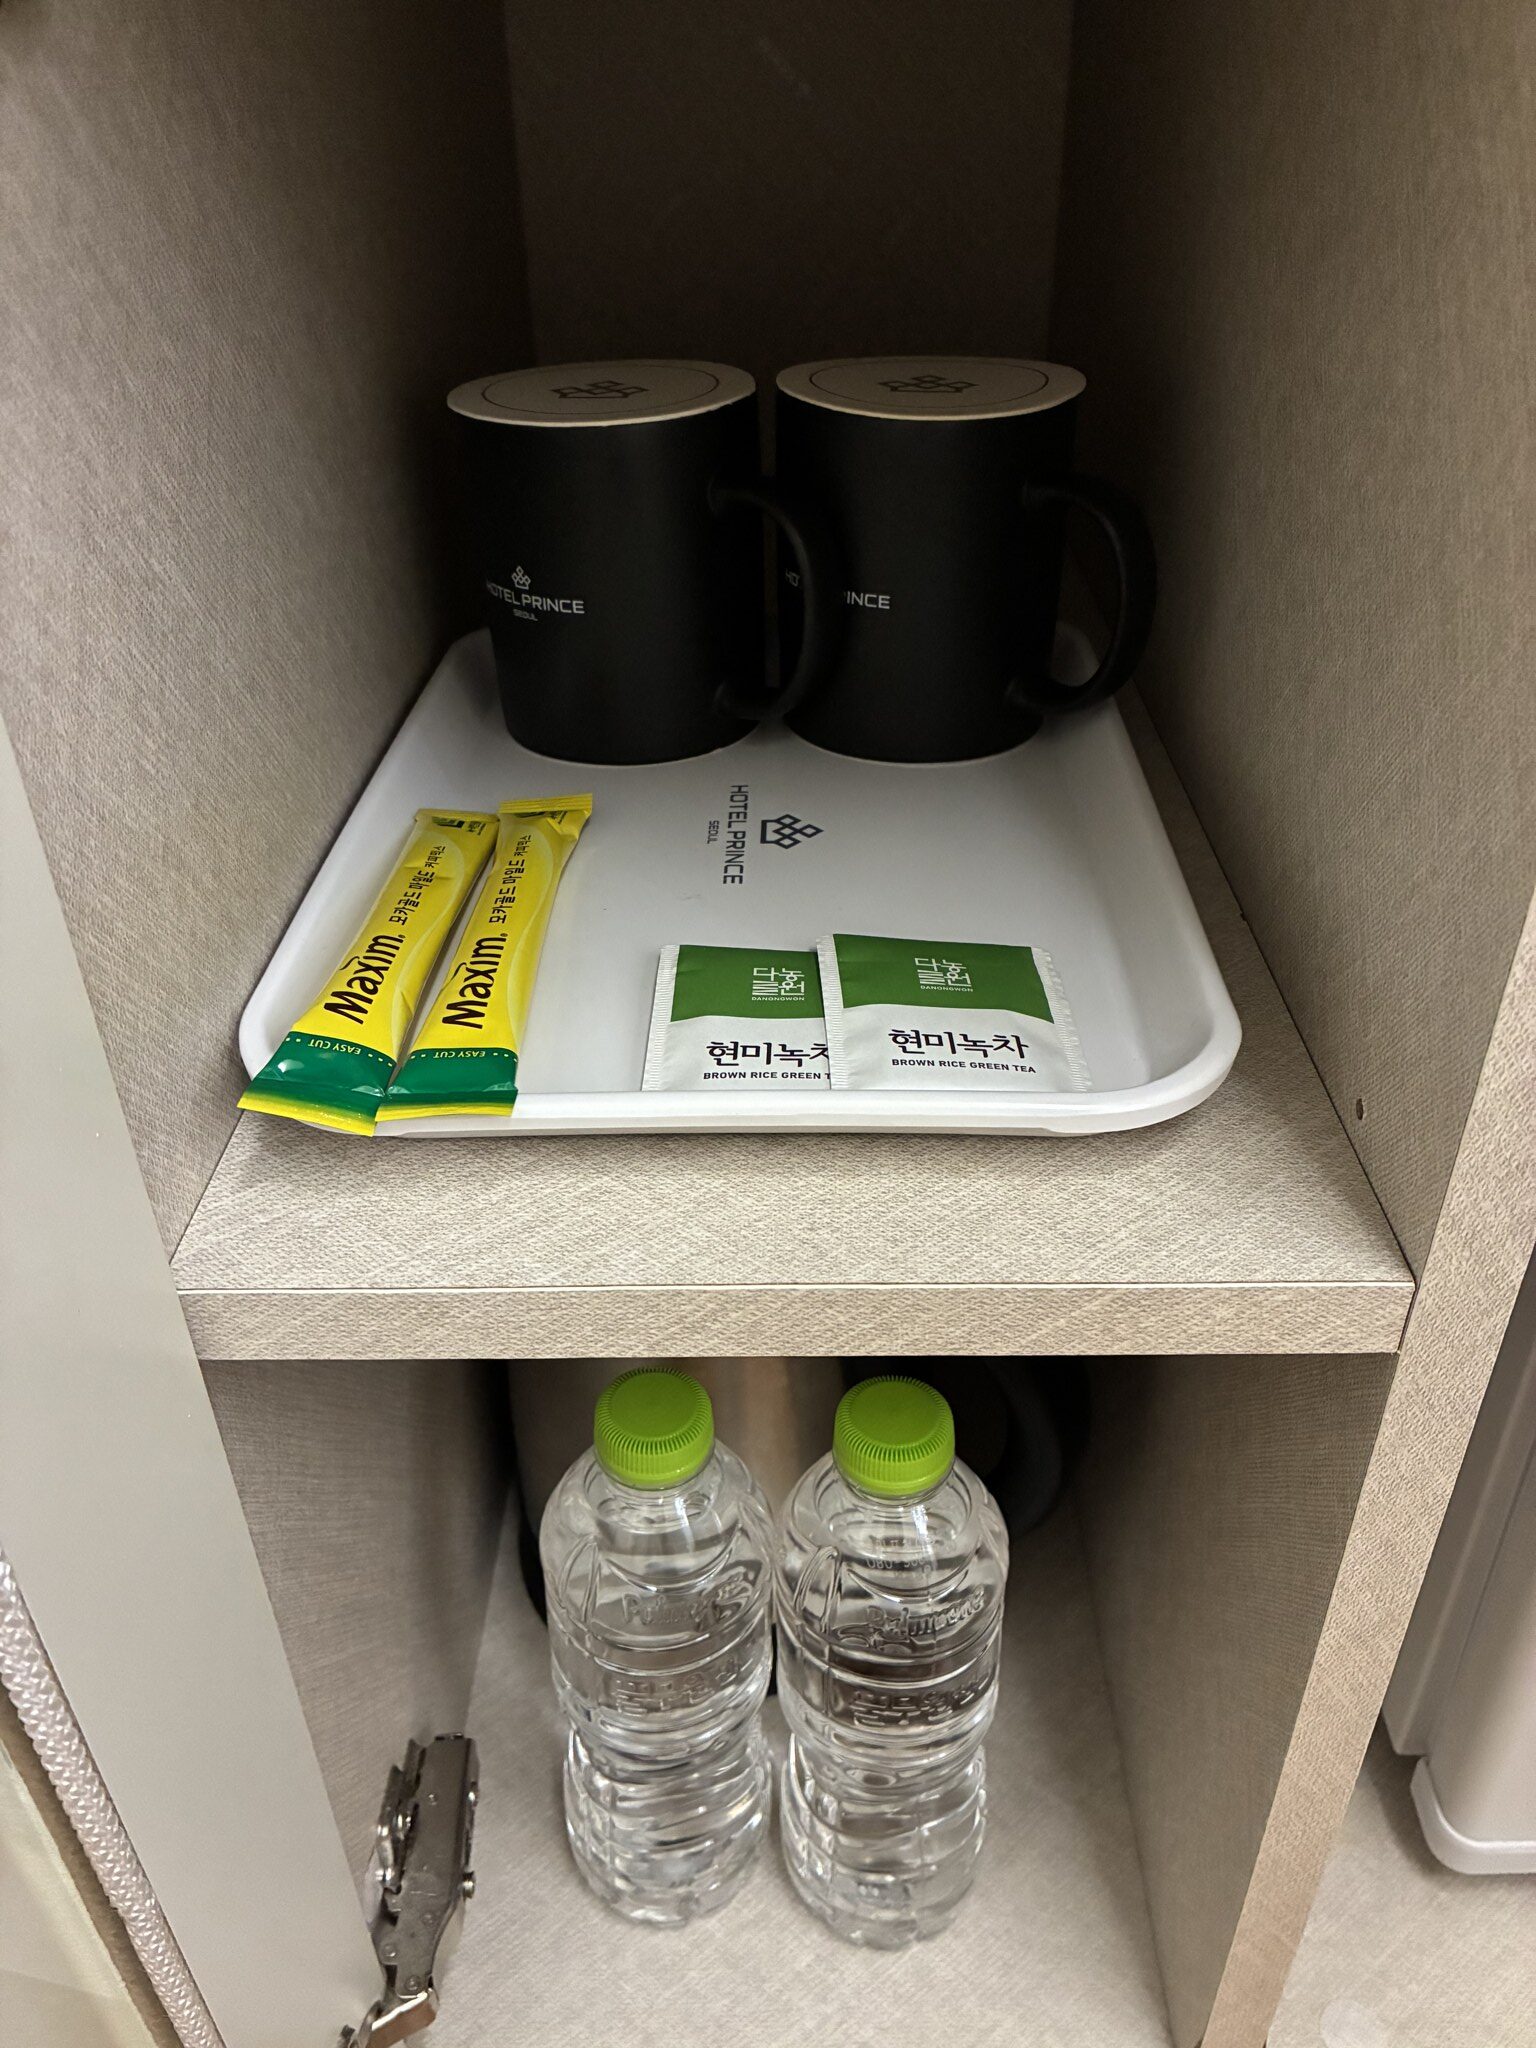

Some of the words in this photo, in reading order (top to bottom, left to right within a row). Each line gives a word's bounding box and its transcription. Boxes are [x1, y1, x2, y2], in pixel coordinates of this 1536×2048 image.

[521, 593, 585, 614] PRINCE
[727, 784, 749, 829] HOTEL
[706, 819, 720, 845] SEOUL
[722, 830, 746, 885] PRINCE
[502, 859, 525, 885] 마일드
[388, 892, 422, 926] 모카골드
[408, 870, 436, 891] 마일드
[488, 886, 517, 924] 모카골드
[323, 934, 405, 1026] Maxim
[441, 936, 507, 1030] Maxim
[307, 1039, 331, 1049] CUT
[332, 1043, 362, 1055] EASY
[432, 1050, 456, 1059] CUT
[457, 1050, 486, 1058] EASY
[888, 1029, 1029, 1059] 현미녹차
[703, 1072, 747, 1080] BROWN
[750, 1071, 778, 1079] RICE
[781, 1071, 821, 1080] GREEN
[891, 1058, 935, 1067] BROWN
[938, 1060, 966, 1068] RICE
[969, 1061, 1010, 1071] GREEN
[1012, 1064, 1037, 1074] TEA
